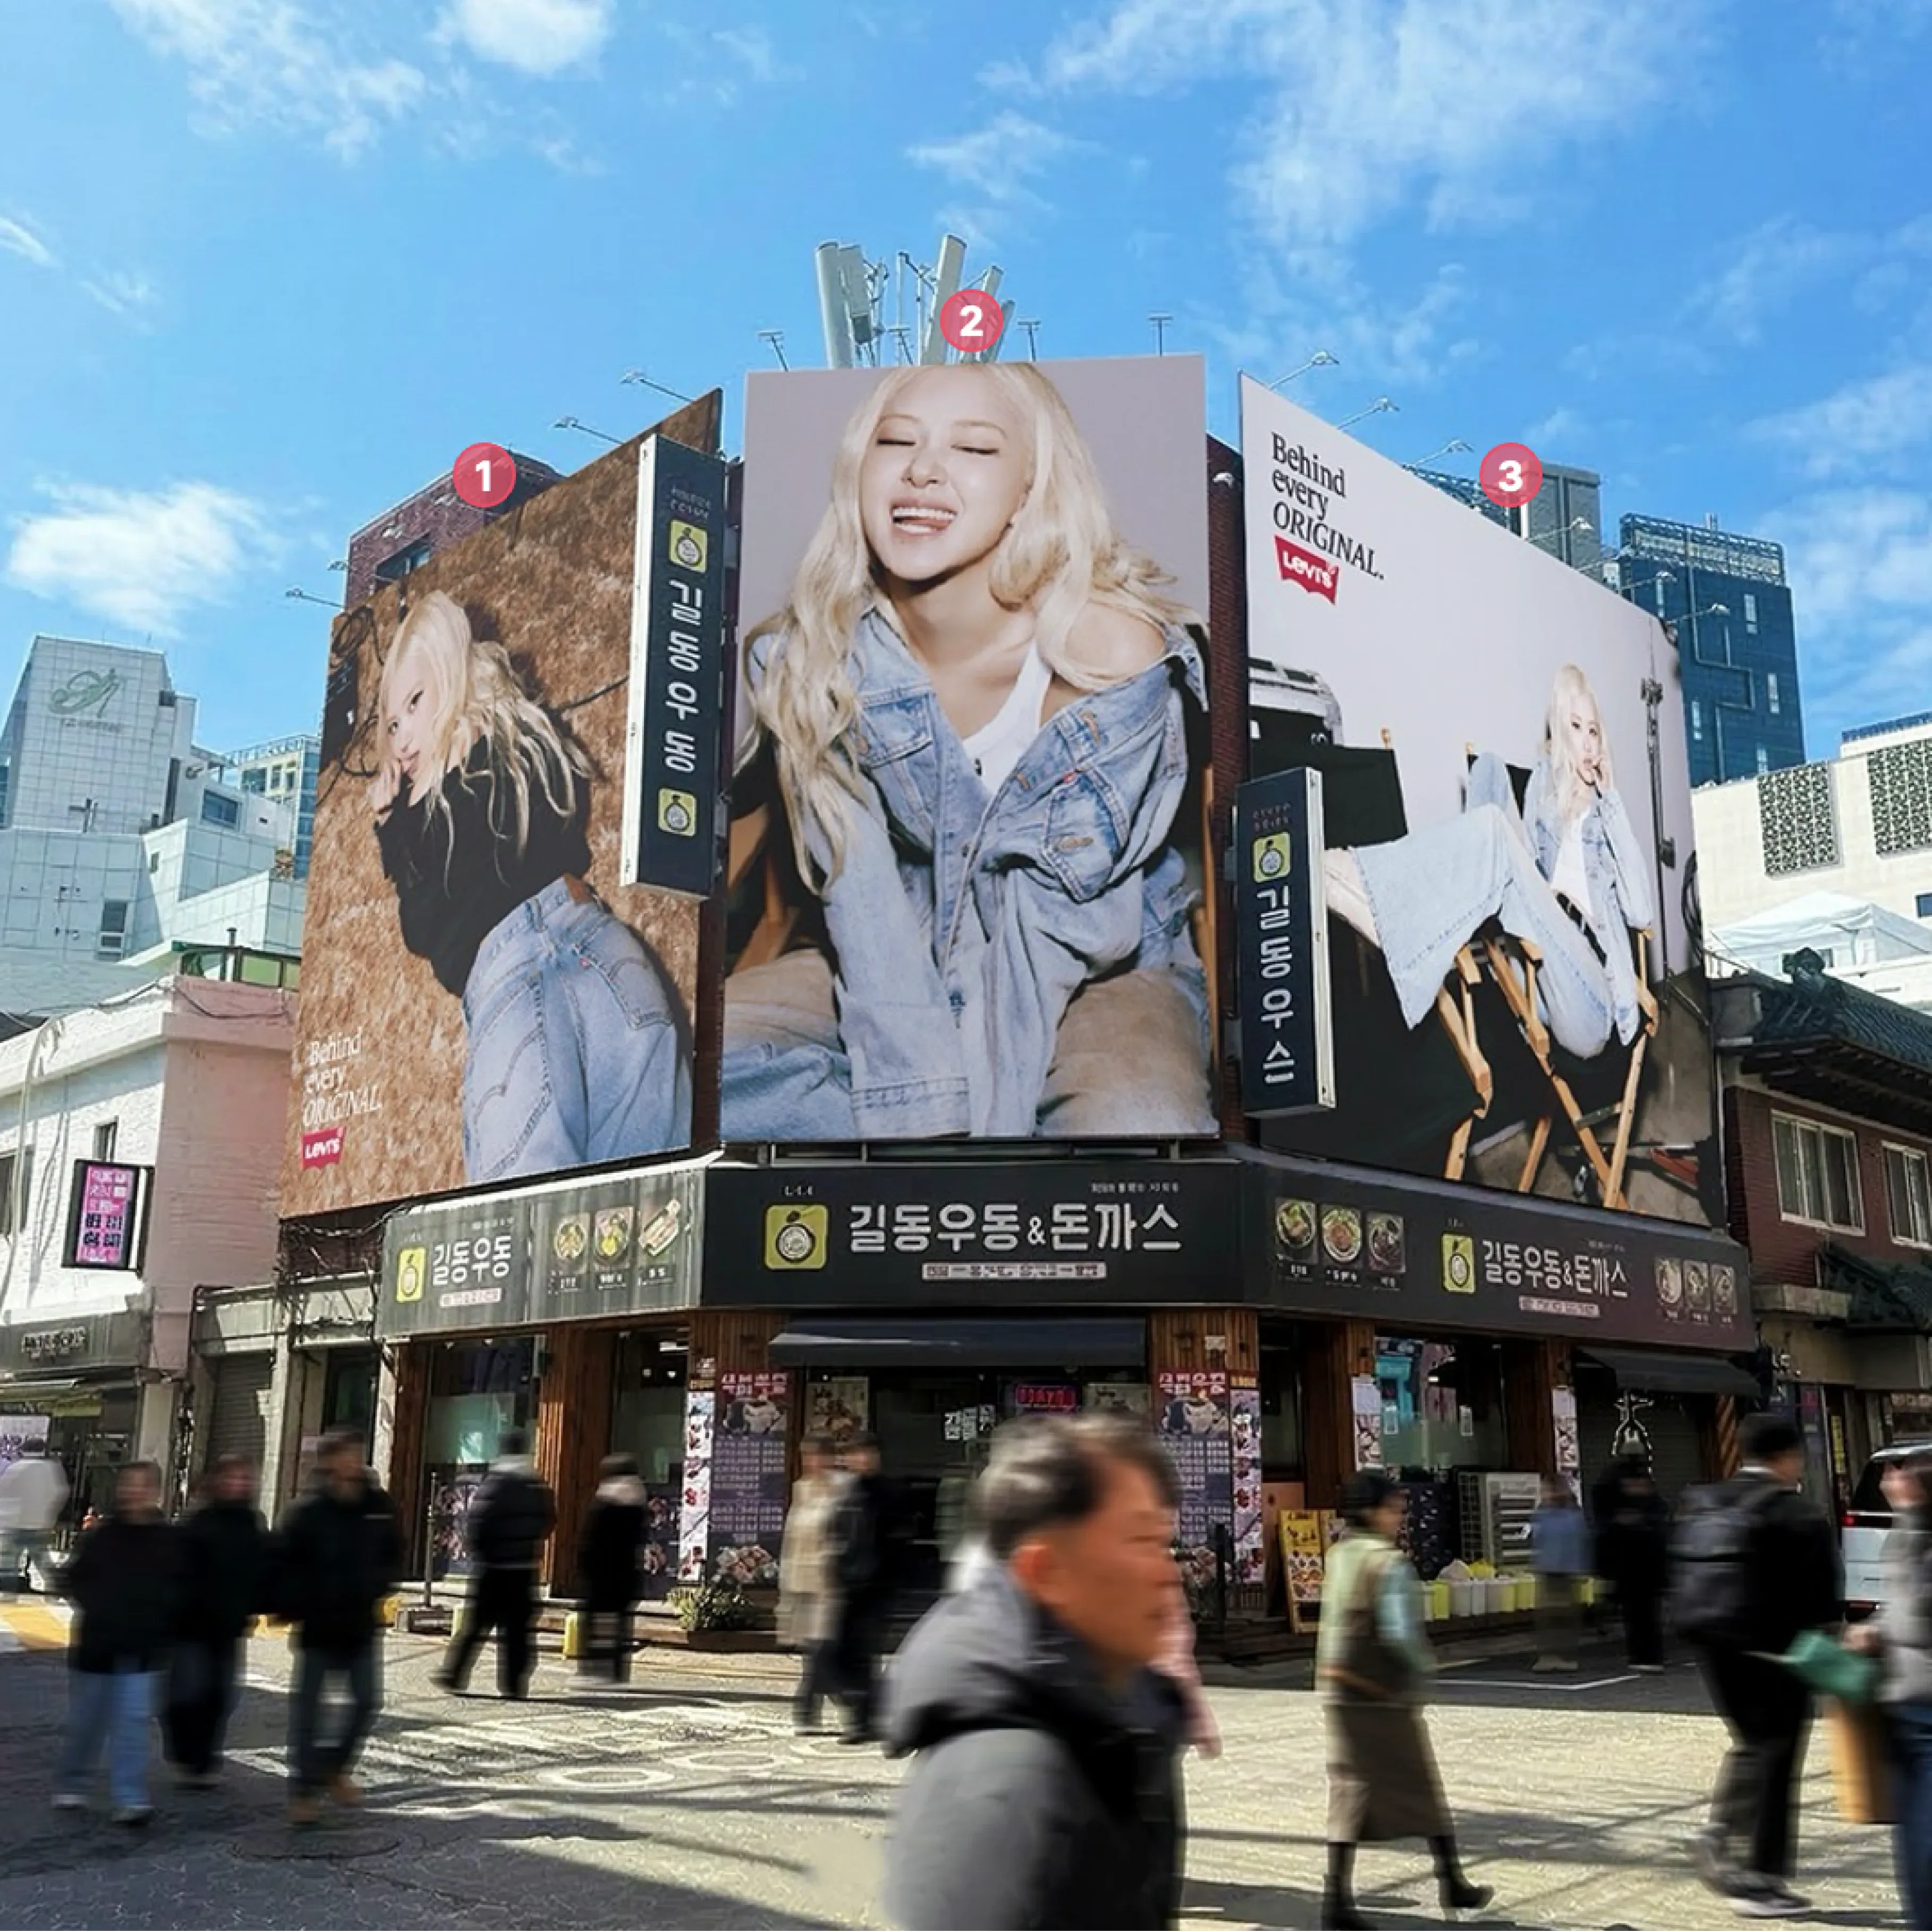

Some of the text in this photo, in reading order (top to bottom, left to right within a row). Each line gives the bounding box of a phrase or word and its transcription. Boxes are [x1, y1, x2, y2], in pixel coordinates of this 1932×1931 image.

[1272, 431, 1346, 498] Behind
[1273, 470, 1328, 520] every
[1273, 501, 1384, 580] ORIGINAL.
[663, 580, 702, 772] 길동우동
[433, 1235, 512, 1286] 길동우동
